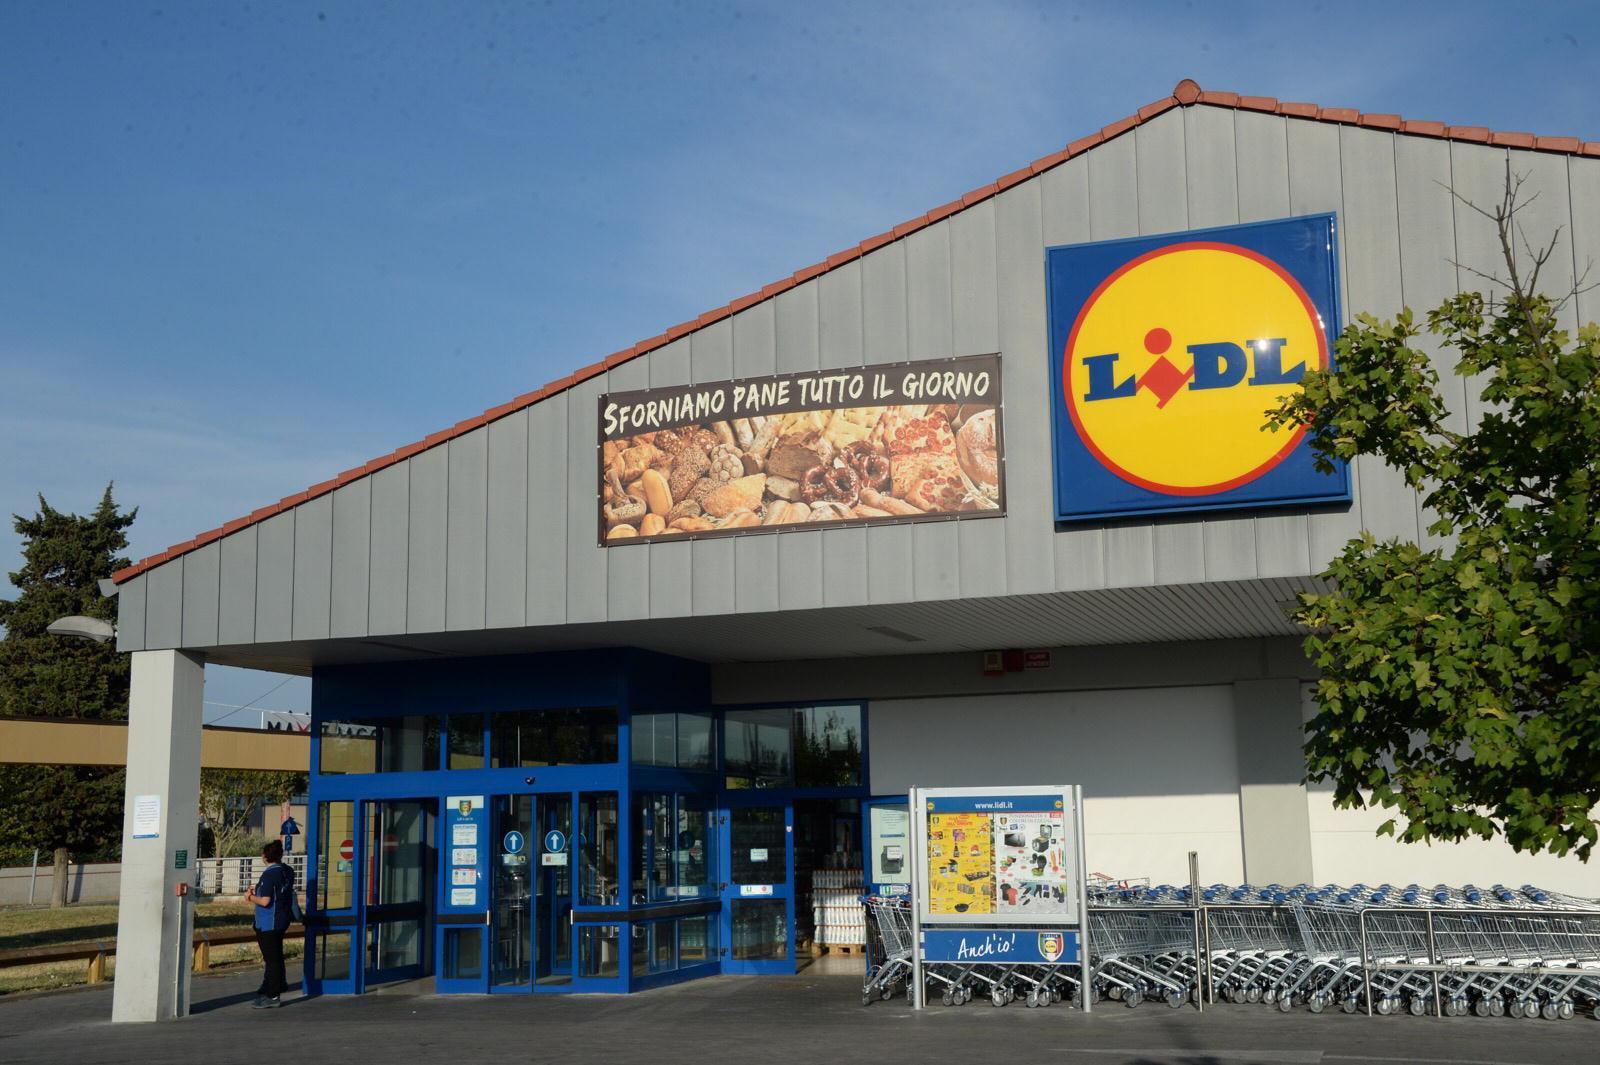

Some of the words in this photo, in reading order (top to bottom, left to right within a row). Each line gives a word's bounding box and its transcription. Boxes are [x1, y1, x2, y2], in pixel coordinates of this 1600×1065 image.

[604, 391, 726, 434] SFORNIAMO
[733, 383, 790, 412] PANE
[797, 374, 863, 404] TUTTO
[873, 374, 894, 399] IL
[902, 371, 990, 399] GIORNO
[975, 801, 1013, 809] www.lidl.it
[957, 933, 1016, 959] Anch'io!
